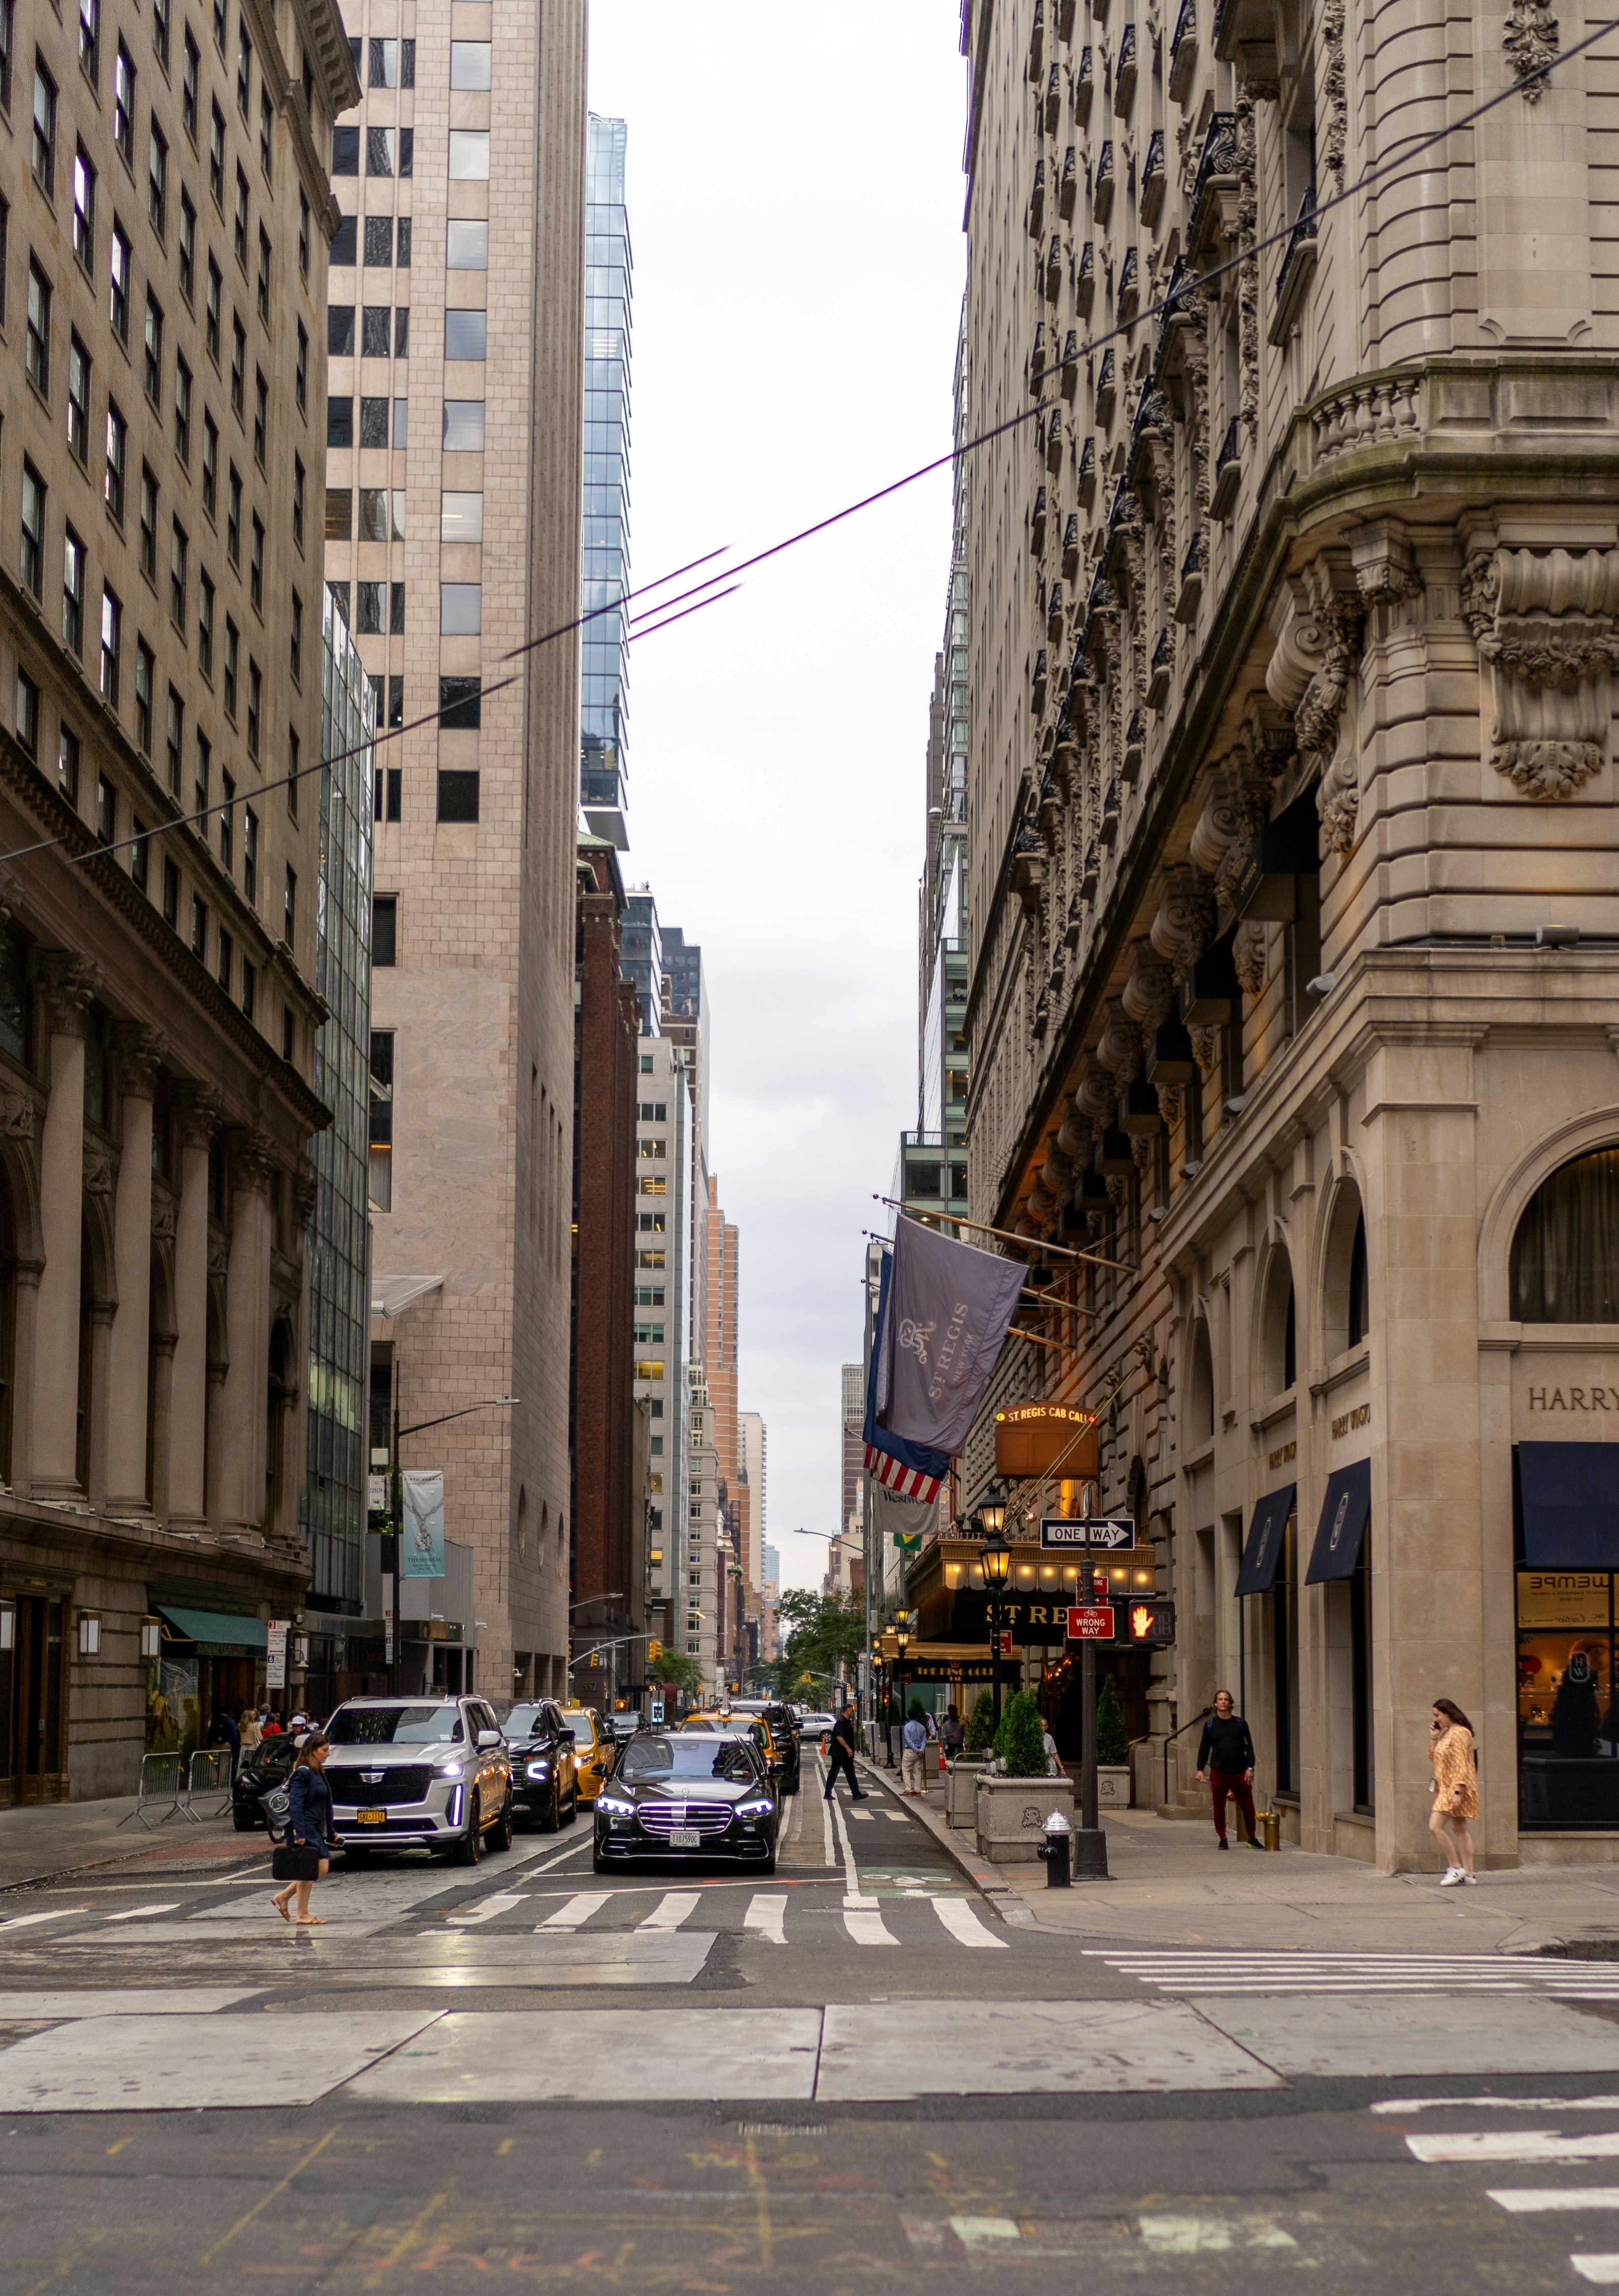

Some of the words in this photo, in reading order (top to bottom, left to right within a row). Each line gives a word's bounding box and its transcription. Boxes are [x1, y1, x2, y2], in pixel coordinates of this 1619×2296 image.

[937, 1303, 968, 1370] REGIS
[953, 1360, 964, 1382] NEW
[961, 1333, 974, 1357] YORK
[1529, 1387, 1619, 1410] HARRY
[1021, 1407, 1046, 1419] REGIS
[1049, 1407, 1066, 1418] CAB
[1068, 1410, 1088, 1424] CALL
[1055, 1529, 1081, 1539] ONE
[1093, 1529, 1120, 1540] WAY
[1076, 1619, 1105, 1627] WRONG
[673, 1835, 697, 1843] T107590C
